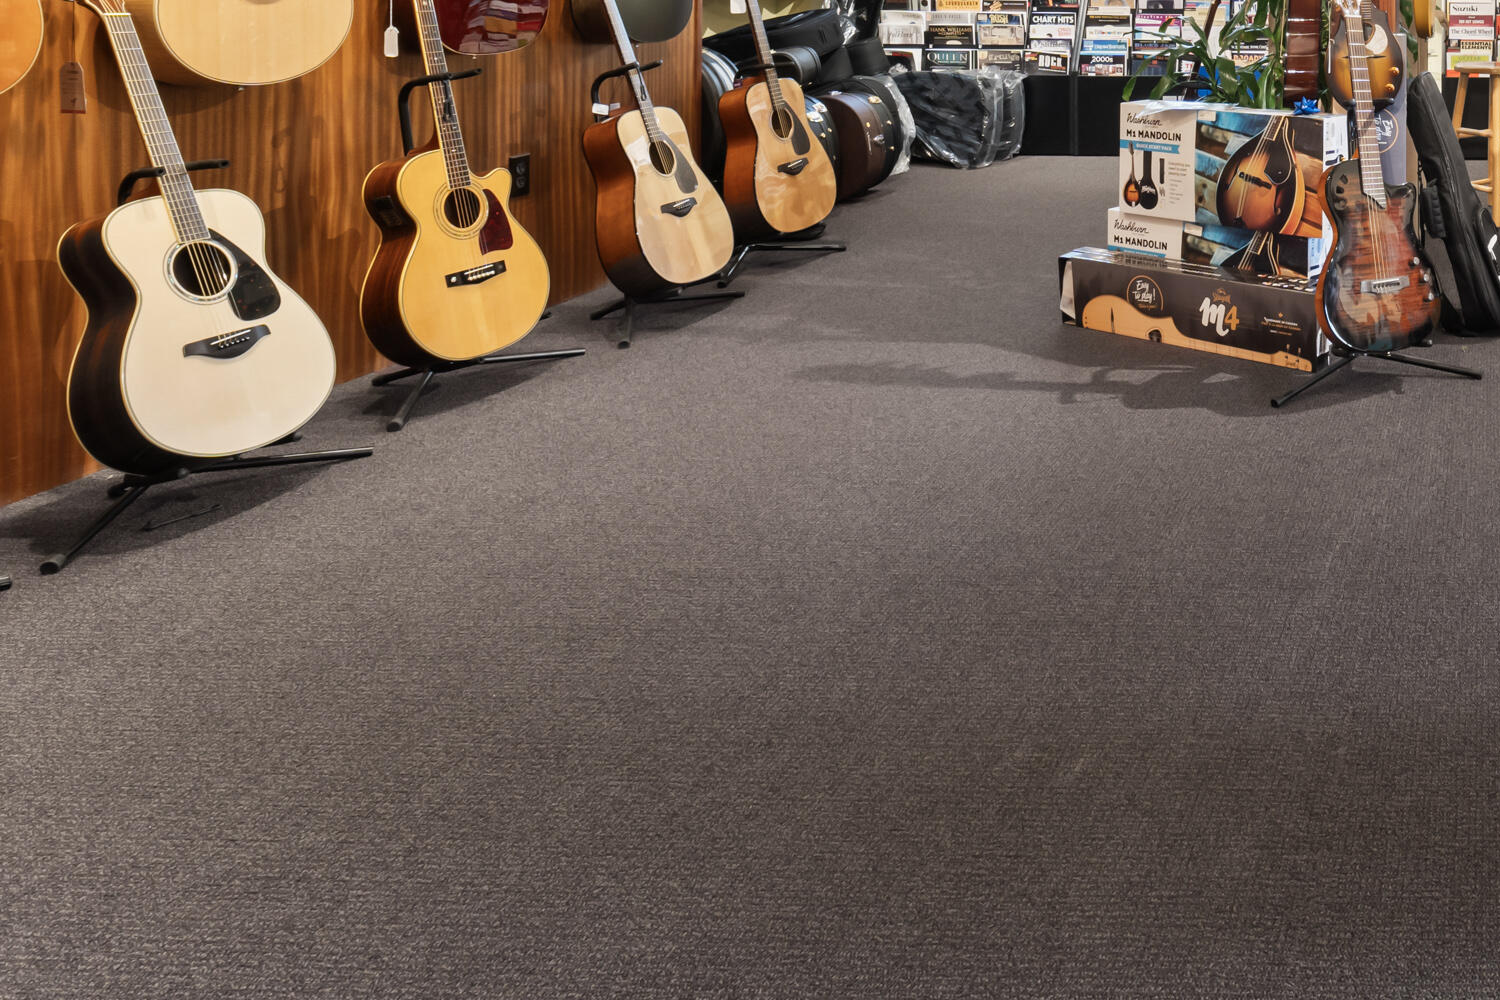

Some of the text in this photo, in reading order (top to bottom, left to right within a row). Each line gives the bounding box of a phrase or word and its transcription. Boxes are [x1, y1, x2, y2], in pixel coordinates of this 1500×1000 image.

[1032, 16, 1074, 24] CHART HITS
[927, 51, 968, 62] QUEEN
[1039, 54, 1063, 67] ROCK
[1090, 56, 1114, 64] 2000s
[1127, 113, 1162, 126] Washburn
[1126, 129, 1182, 142] M1 MANDOLIN
[1114, 219, 1150, 234] Washburn
[1114, 234, 1168, 250] M1 MANDOLIN
[1136, 280, 1150, 292] Easy
